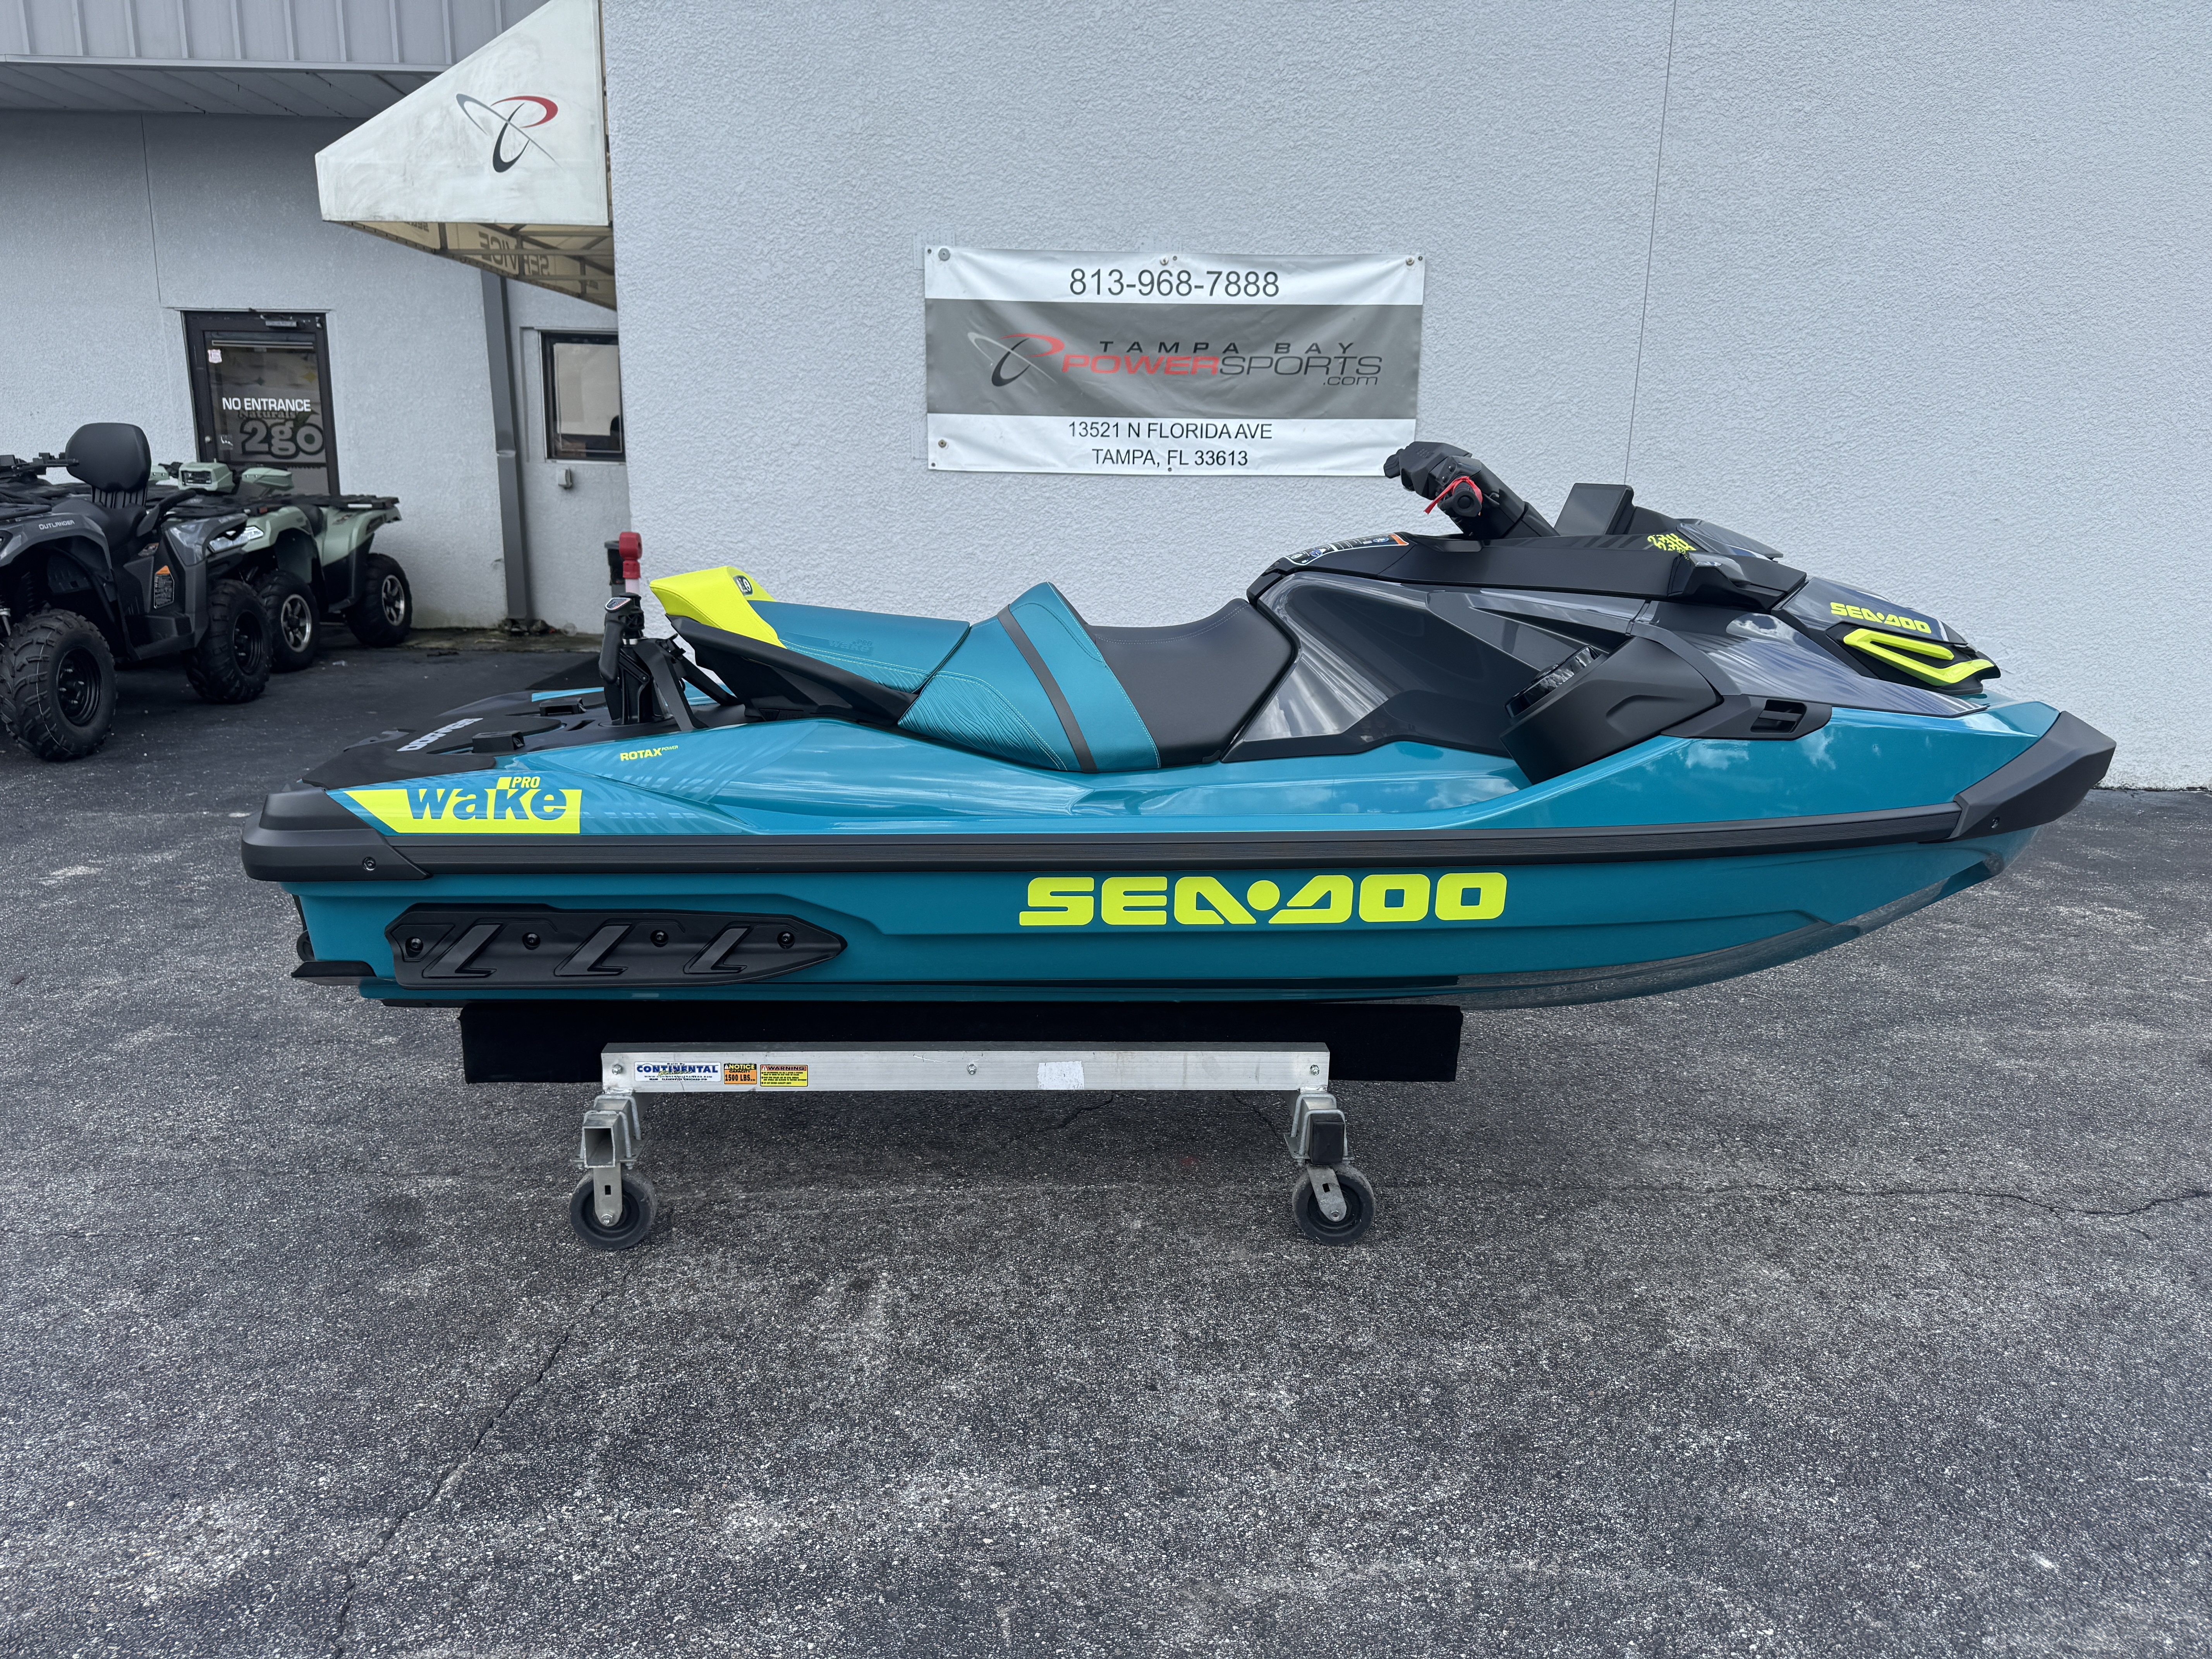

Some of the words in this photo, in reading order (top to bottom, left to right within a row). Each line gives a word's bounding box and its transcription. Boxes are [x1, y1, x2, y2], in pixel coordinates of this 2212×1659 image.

[1070, 268, 1279, 297] 813-968-7888
[1100, 341, 1239, 354] TAMPA
[1274, 342, 1353, 354] BAY
[1061, 354, 1382, 376] POWERSPORTS
[1322, 376, 1378, 386] .com
[222, 397, 241, 410] NO
[244, 398, 311, 412] ENTRANCE
[1069, 421, 1119, 438] 13521
[1128, 422, 1140, 438] N
[1148, 422, 1232, 439] FLORIDA
[1234, 423, 1273, 439] AVE
[1092, 449, 1160, 468] TAMPA,
[1168, 450, 1189, 465] FL
[1194, 450, 1248, 466] 33613
[39, 520, 75, 530] OUTLANDER
[620, 747, 662, 761] ROTAX
[511, 776, 541, 788] PRO
[406, 777, 567, 820] wake
[636, 1065, 718, 1073] CONTINENTAL
